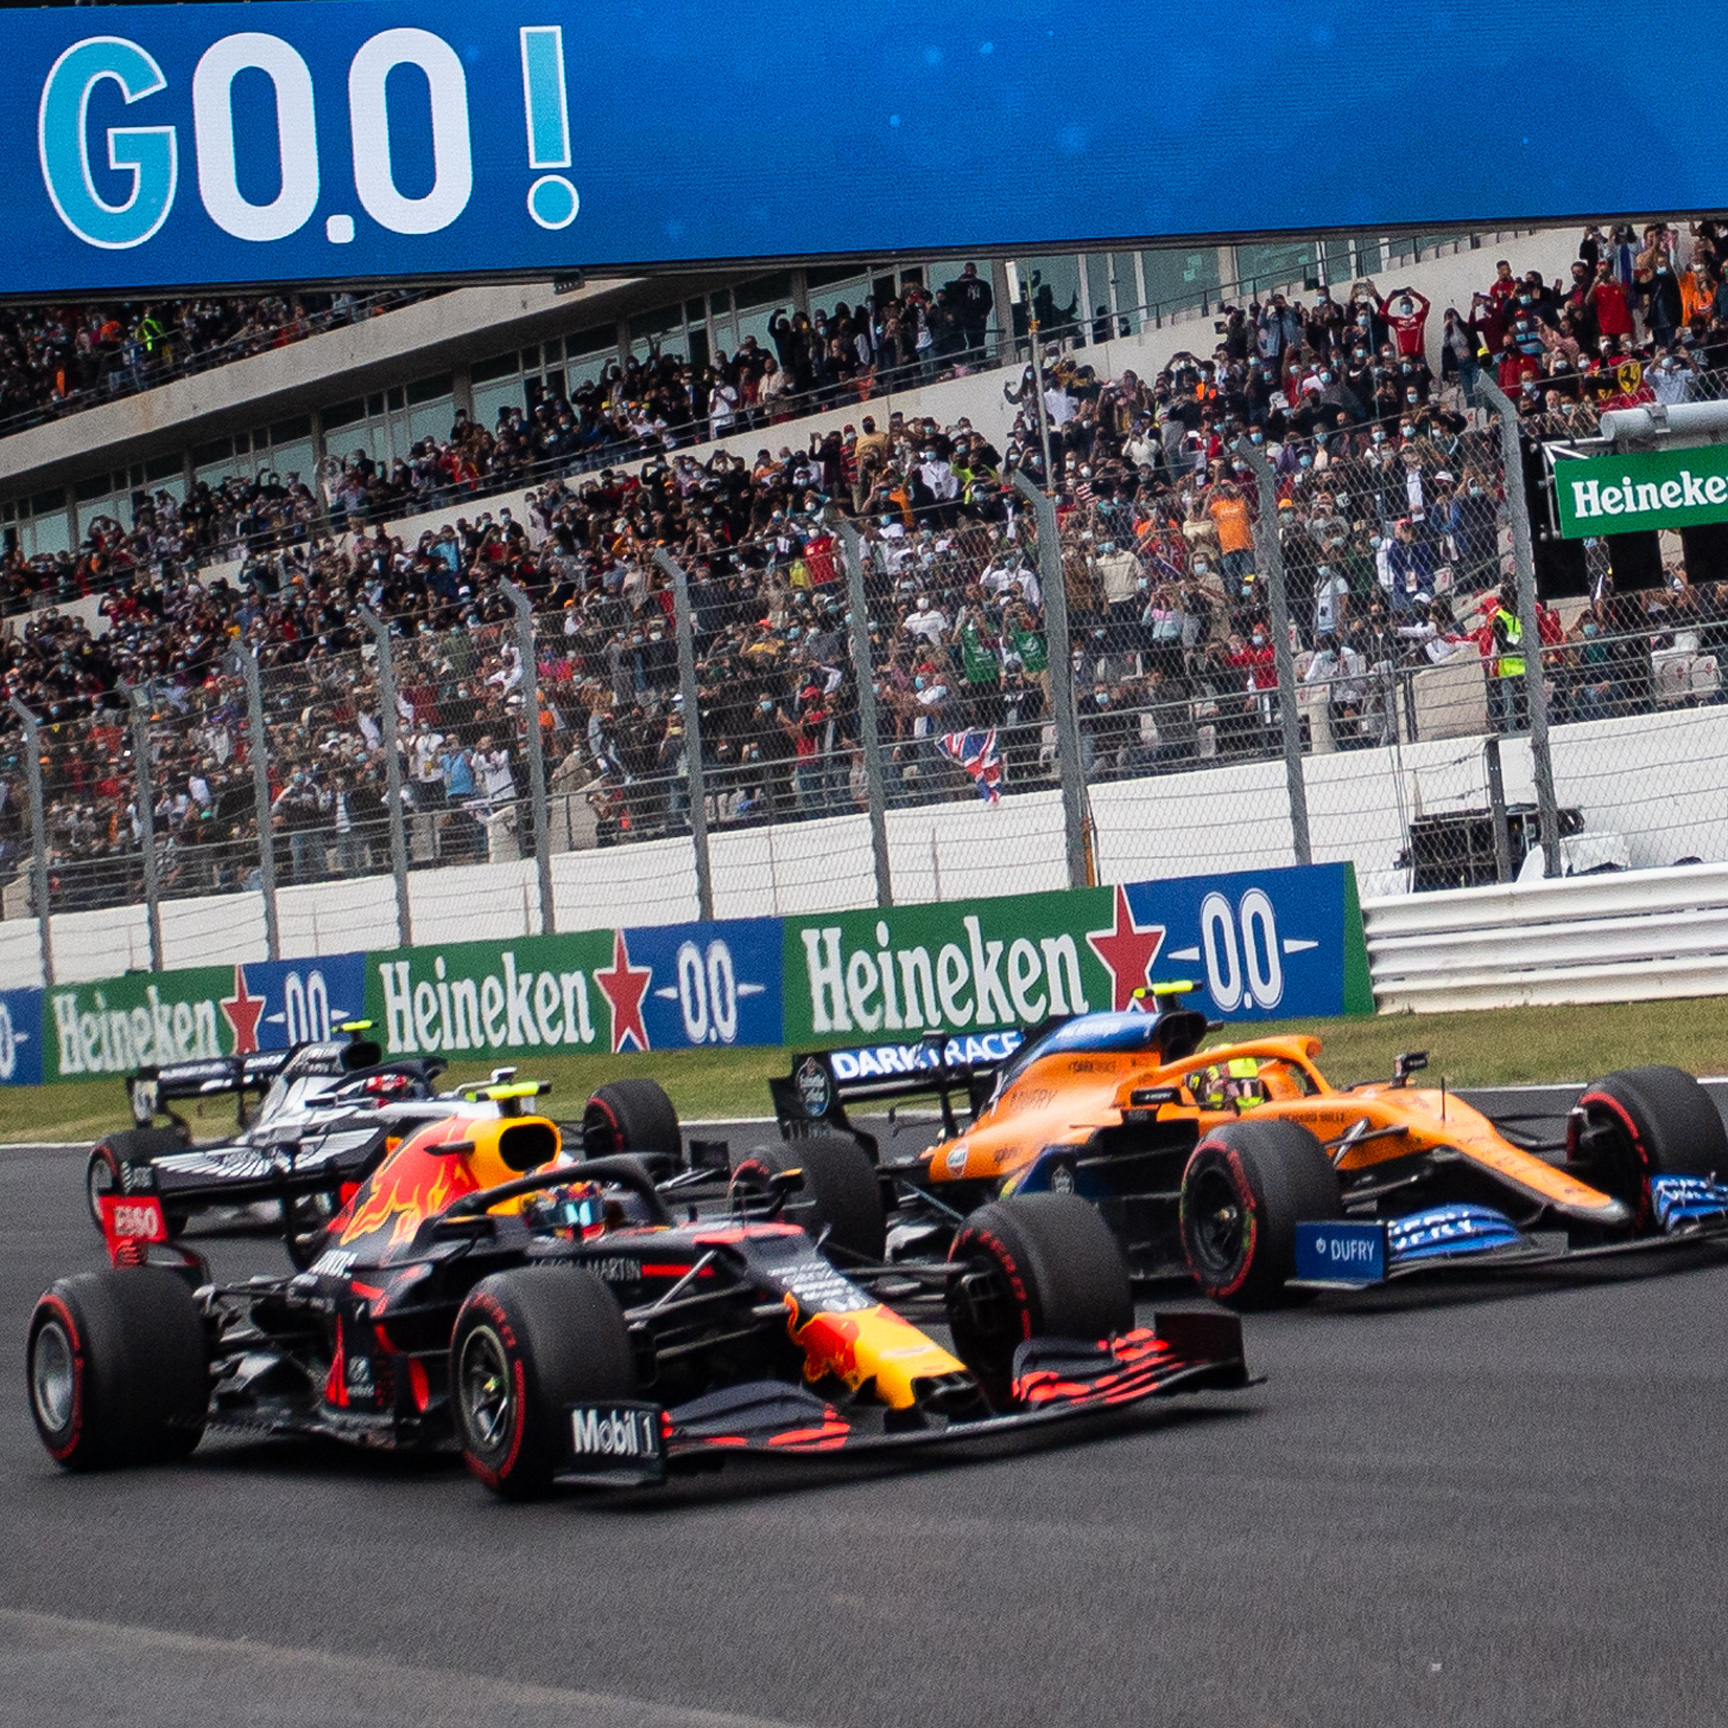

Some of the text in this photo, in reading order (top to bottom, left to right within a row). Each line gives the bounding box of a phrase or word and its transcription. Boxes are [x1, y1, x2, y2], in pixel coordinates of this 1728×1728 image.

[378, 939, 740, 1055] Heineken 0.0
[800, 887, 1286, 1034] Heineken 0.0
[52, 985, 225, 1076] Heineken
[1330, 1239, 1376, 1262] DUFRY
[572, 1408, 639, 1455] Mobil
